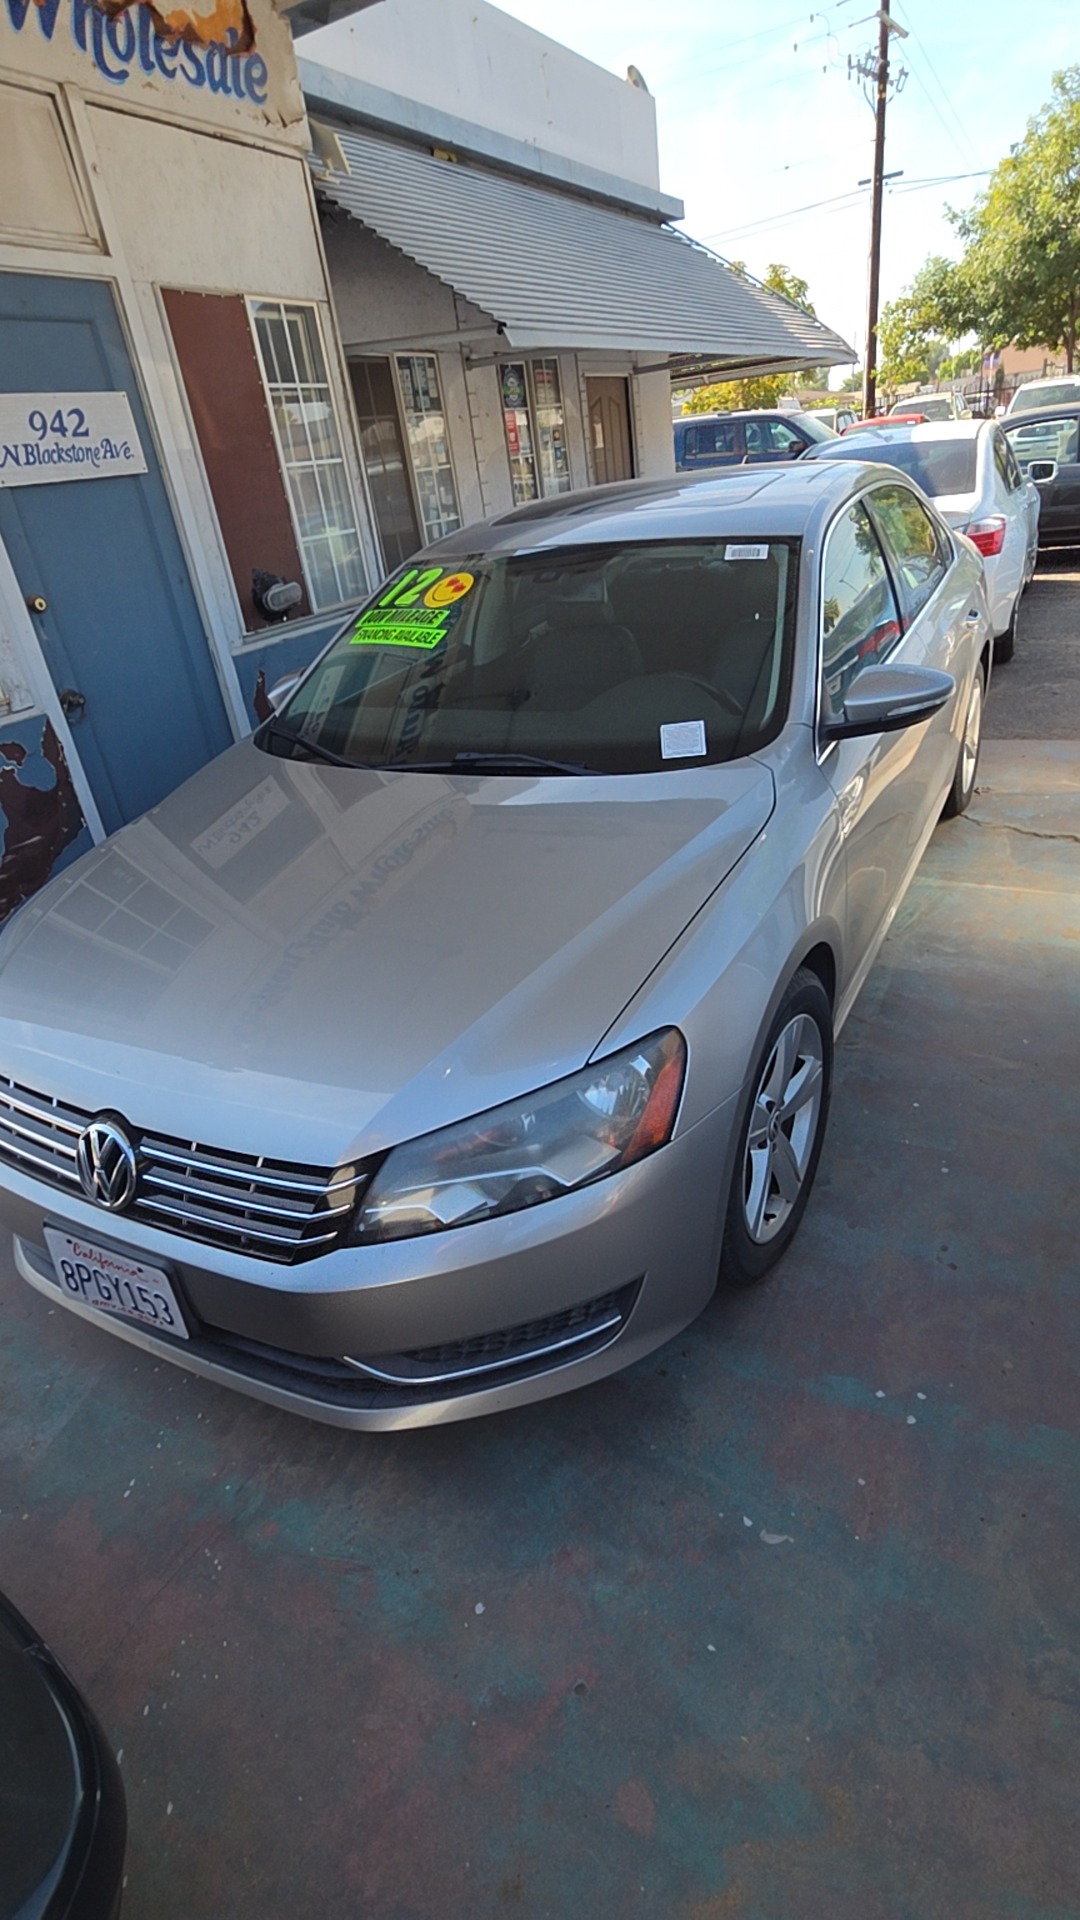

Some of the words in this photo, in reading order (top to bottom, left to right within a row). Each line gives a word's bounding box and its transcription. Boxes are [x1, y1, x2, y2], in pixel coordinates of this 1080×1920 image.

[28, 408, 89, 441] 942
[0, 444, 22, 468] N
[22, 442, 101, 468] Blackstone
[378, 567, 443, 607] 12
[384, 610, 443, 627] MILEAGE
[391, 631, 440, 645] AVAILABLE
[73, 1242, 140, 1277] California
[60, 1259, 175, 1326] 8PGY153
